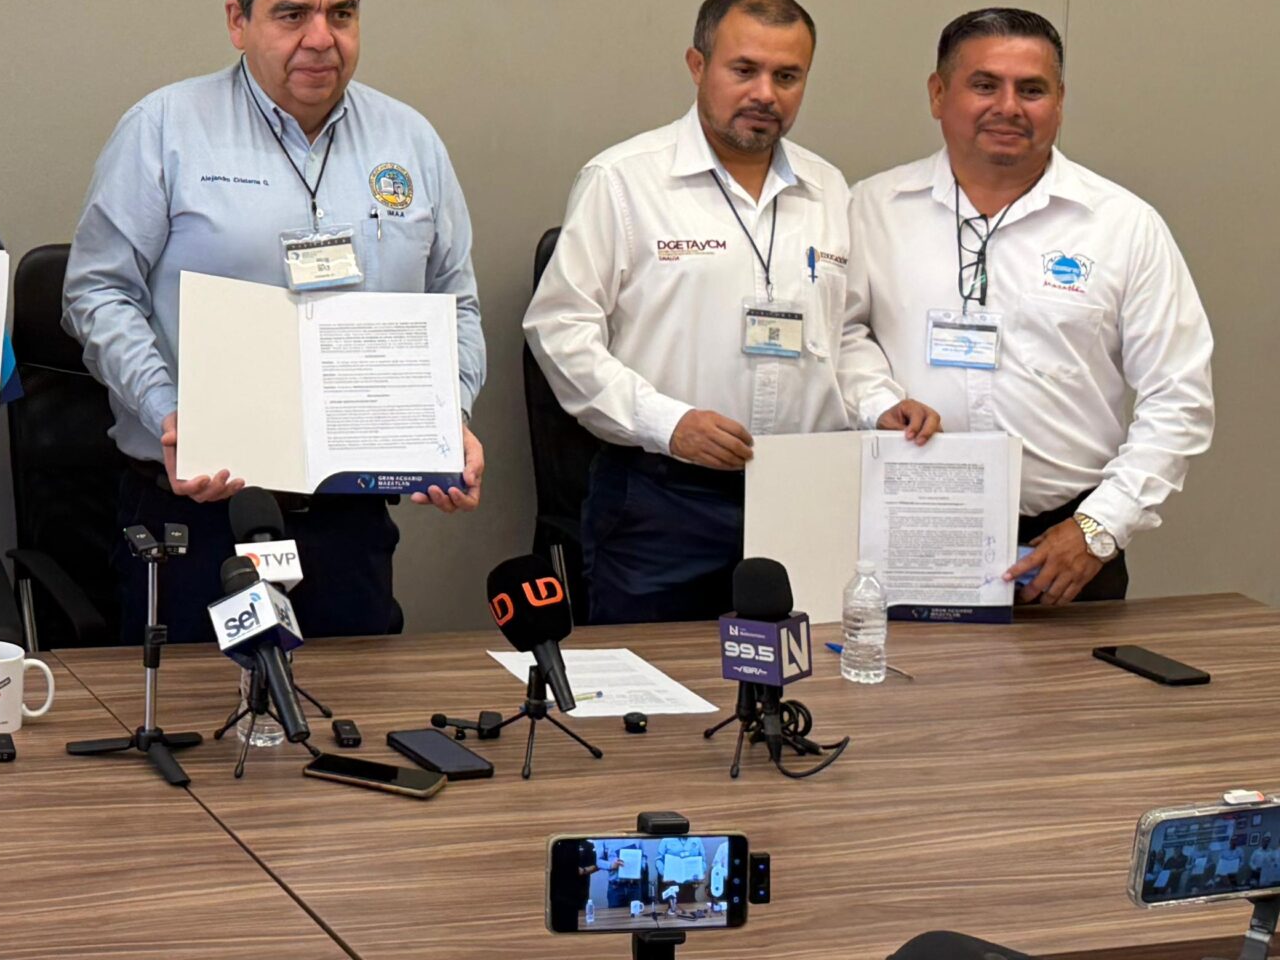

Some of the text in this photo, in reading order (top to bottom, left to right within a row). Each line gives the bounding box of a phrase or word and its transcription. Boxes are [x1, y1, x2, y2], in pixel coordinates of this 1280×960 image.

[260, 552, 296, 566] TVP
[224, 602, 260, 638] sel
[724, 641, 775, 663] 99.5
